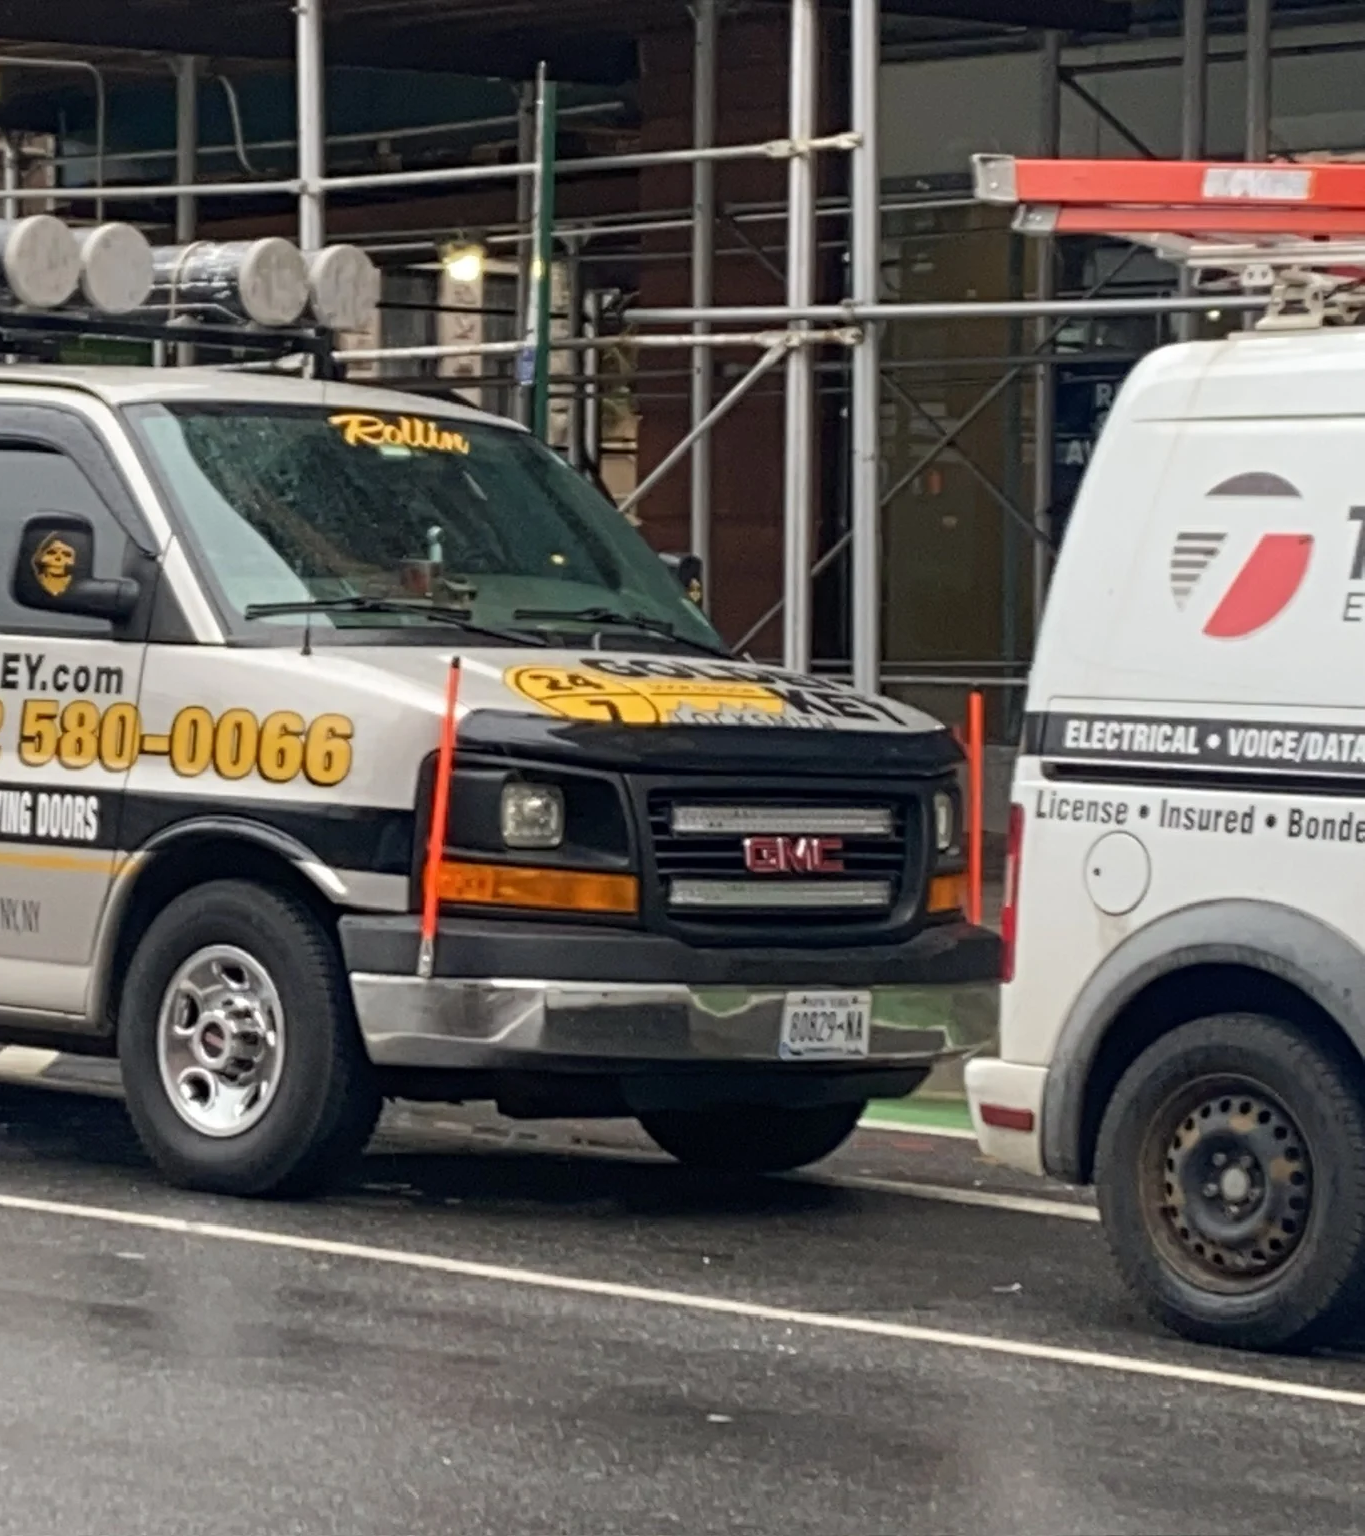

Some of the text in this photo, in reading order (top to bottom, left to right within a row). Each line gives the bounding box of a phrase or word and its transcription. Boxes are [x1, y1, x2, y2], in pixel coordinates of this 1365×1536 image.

[327, 413, 470, 455] Rollin
[528, 669, 605, 691] 24
[580, 658, 850, 695] GOLDEN
[763, 686, 909, 726] KEY
[19, 699, 354, 787] 580-0066
[1064, 720, 1365, 763] ELECTRICAL VOICE/DATA
[36, 793, 98, 841] DOORS
[1035, 790, 1129, 825] License
[1159, 799, 1256, 835] Insured
[743, 837, 845, 873] GMC
